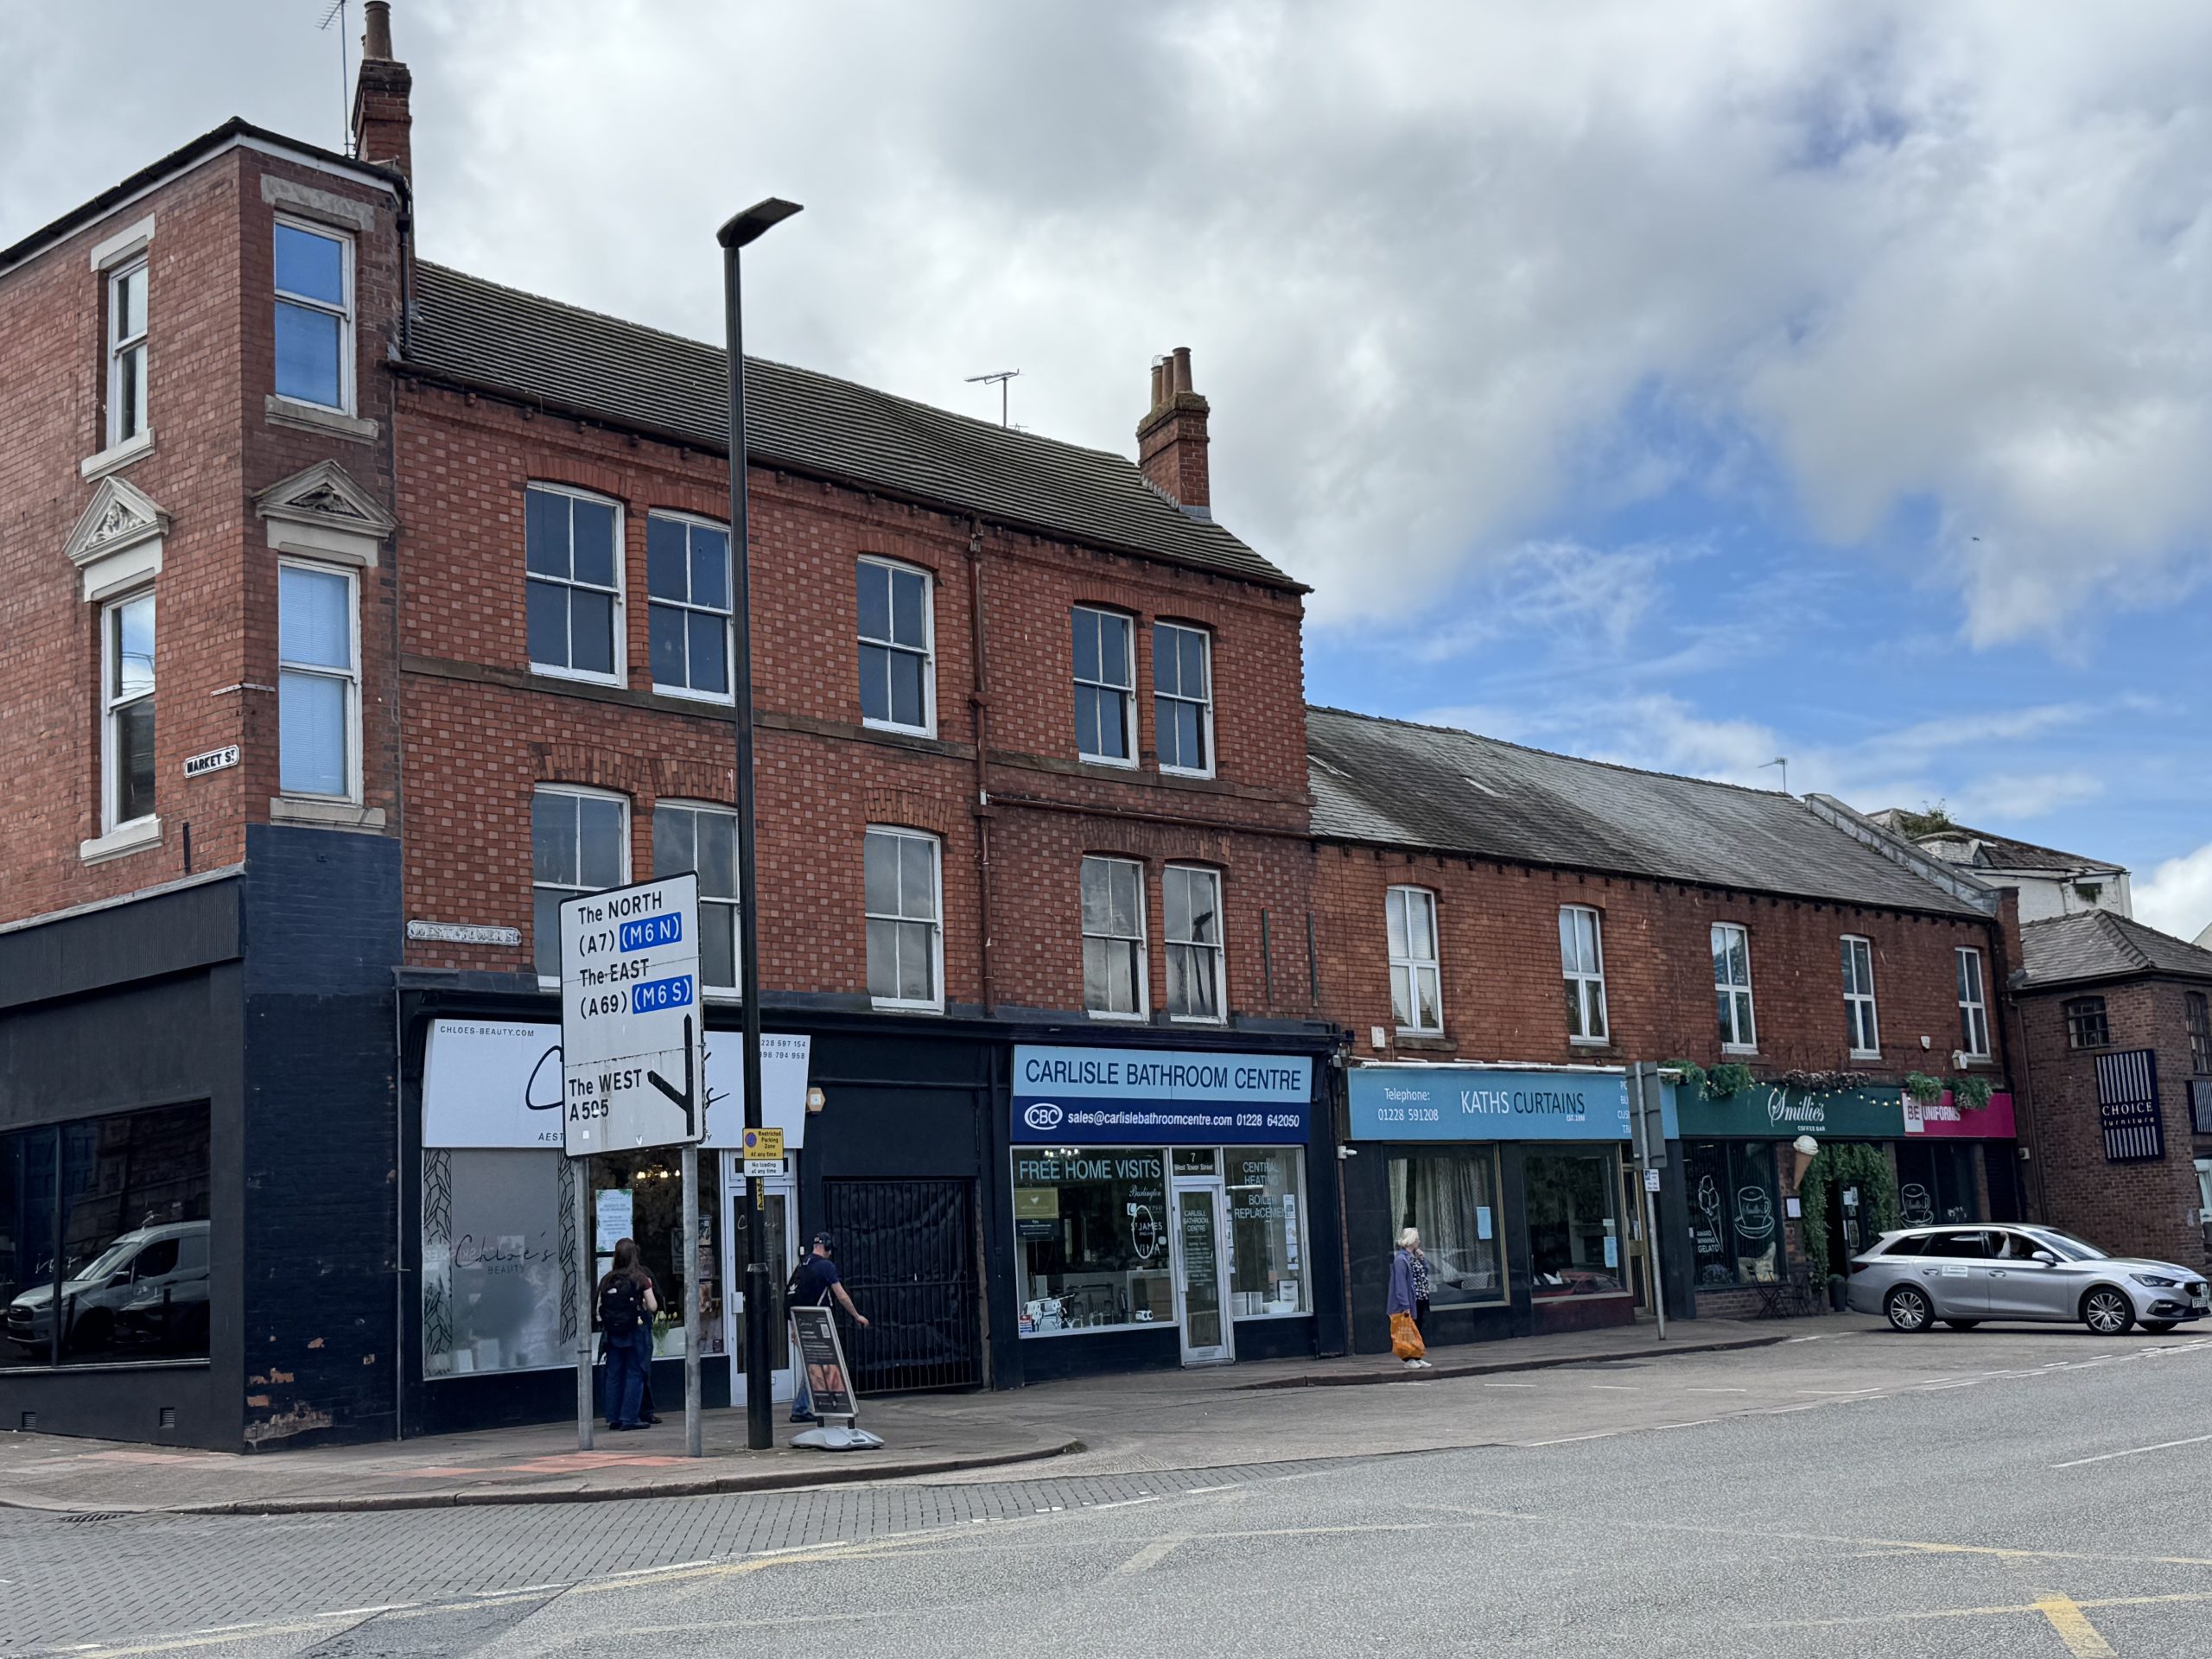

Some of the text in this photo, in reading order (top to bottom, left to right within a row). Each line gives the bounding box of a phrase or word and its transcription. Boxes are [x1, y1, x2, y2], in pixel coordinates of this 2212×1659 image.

[187, 753, 222, 773] MARKET
[578, 891, 662, 925] The NORTH
[579, 915, 680, 957] (A7) (M6 N)
[580, 958, 649, 987] The EAST
[581, 978, 690, 1020] (A69) (M6 S)
[440, 1026, 534, 1037] CHLOES-BEAUTY.COM
[569, 1069, 642, 1096] The WEST
[1026, 1059, 1301, 1090] CARLISLE BATHROOM CENTRE
[1384, 1088, 1430, 1103] Telephone:
[1460, 1090, 1586, 1114] KATHS CURTAINS
[1029, 1109, 1058, 1124] CBC
[1377, 1109, 1439, 1121] 01228 591208
[1908, 1106, 1961, 1121] BE UNIFORMS
[2102, 1102, 2152, 1116] CHOICE
[1067, 1110, 1300, 1127] sales@carlislebathroomcentre.com 01228 642050
[2104, 1117, 2155, 1127] furniture
[1191, 1152, 1196, 1163] 7
[1019, 1160, 1161, 1179] FREE HOME VISITS
[1243, 1162, 1279, 1173] CENTRAL
[1244, 1175, 1278, 1186] HEATING
[1249, 1194, 1276, 1205] BOILER
[455, 1231, 555, 1268] Chloe's
